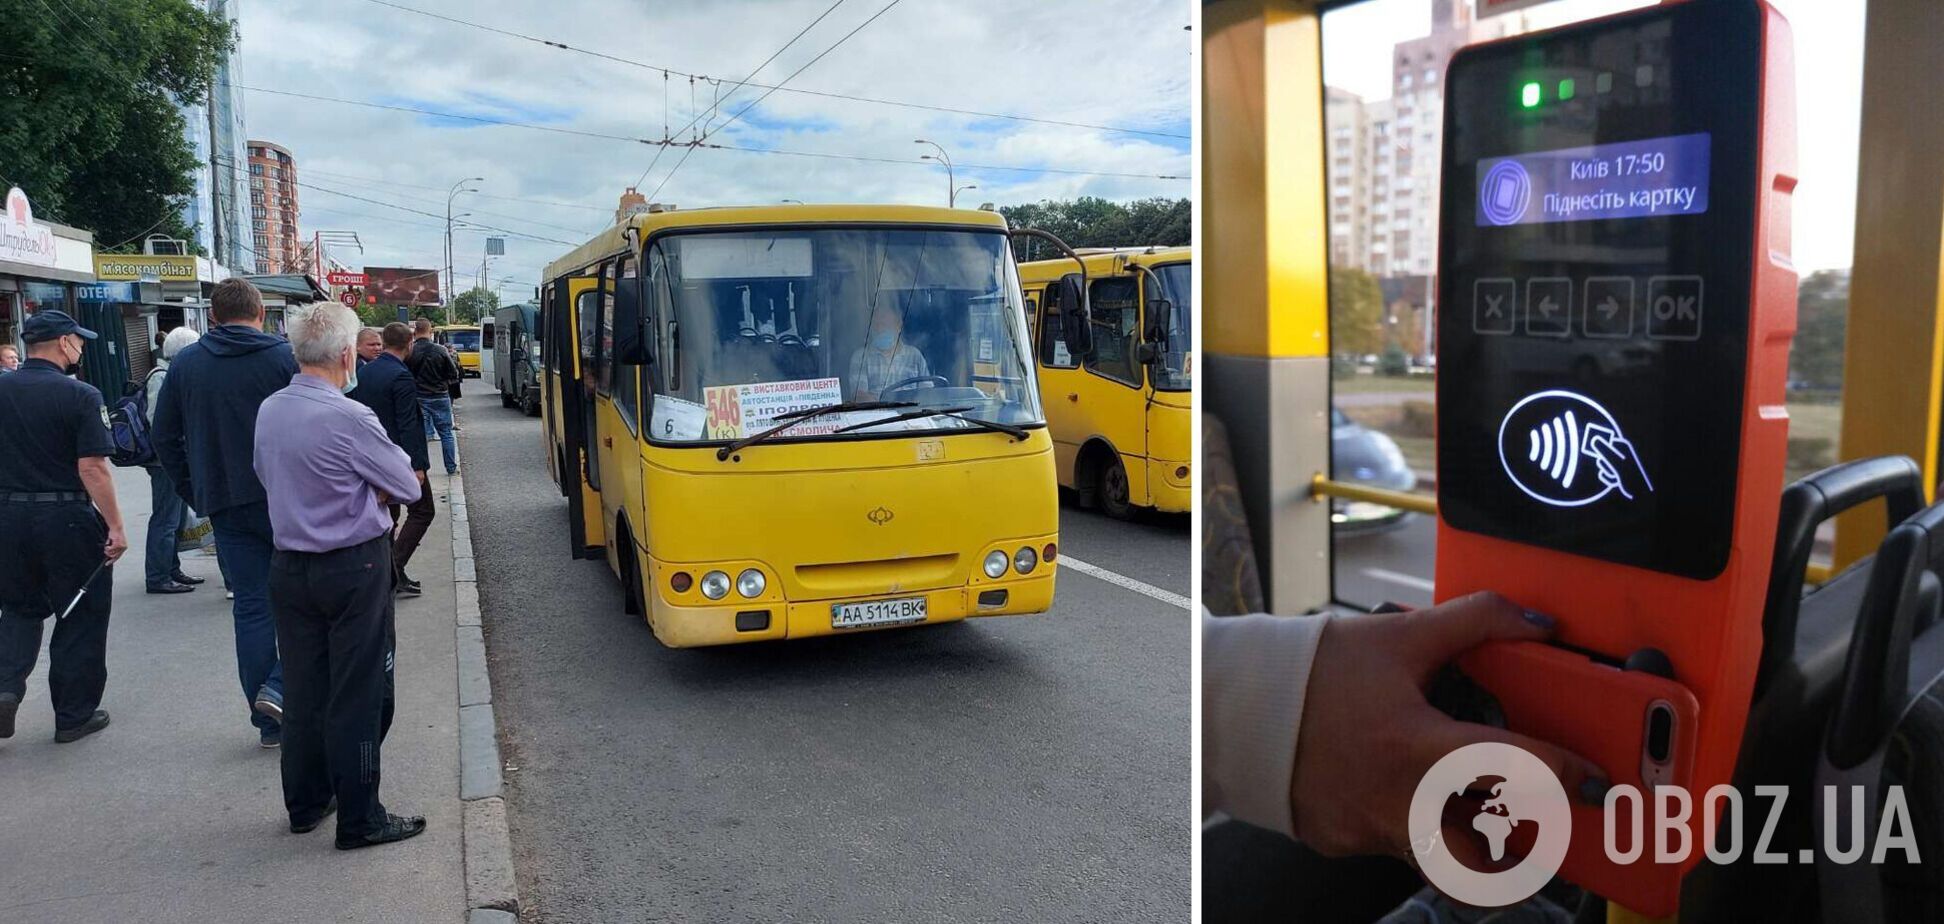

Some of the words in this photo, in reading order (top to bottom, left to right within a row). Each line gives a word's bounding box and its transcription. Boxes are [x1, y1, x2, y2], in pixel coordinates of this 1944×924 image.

[1571, 158, 1608, 180] Київ
[1616, 152, 1665, 176] 17:50
[1544, 189, 1624, 216] Піднесіть
[1630, 186, 1697, 212] картку
[332, 274, 364, 284] ГРОШІ
[1654, 296, 1696, 320] OK
[813, 380, 838, 391] ЦЕНТР
[707, 387, 741, 429] 546
[665, 418, 675, 435] 6
[843, 607, 862, 622] AA
[866, 603, 898, 619] 5114
[902, 601, 921, 616] BK
